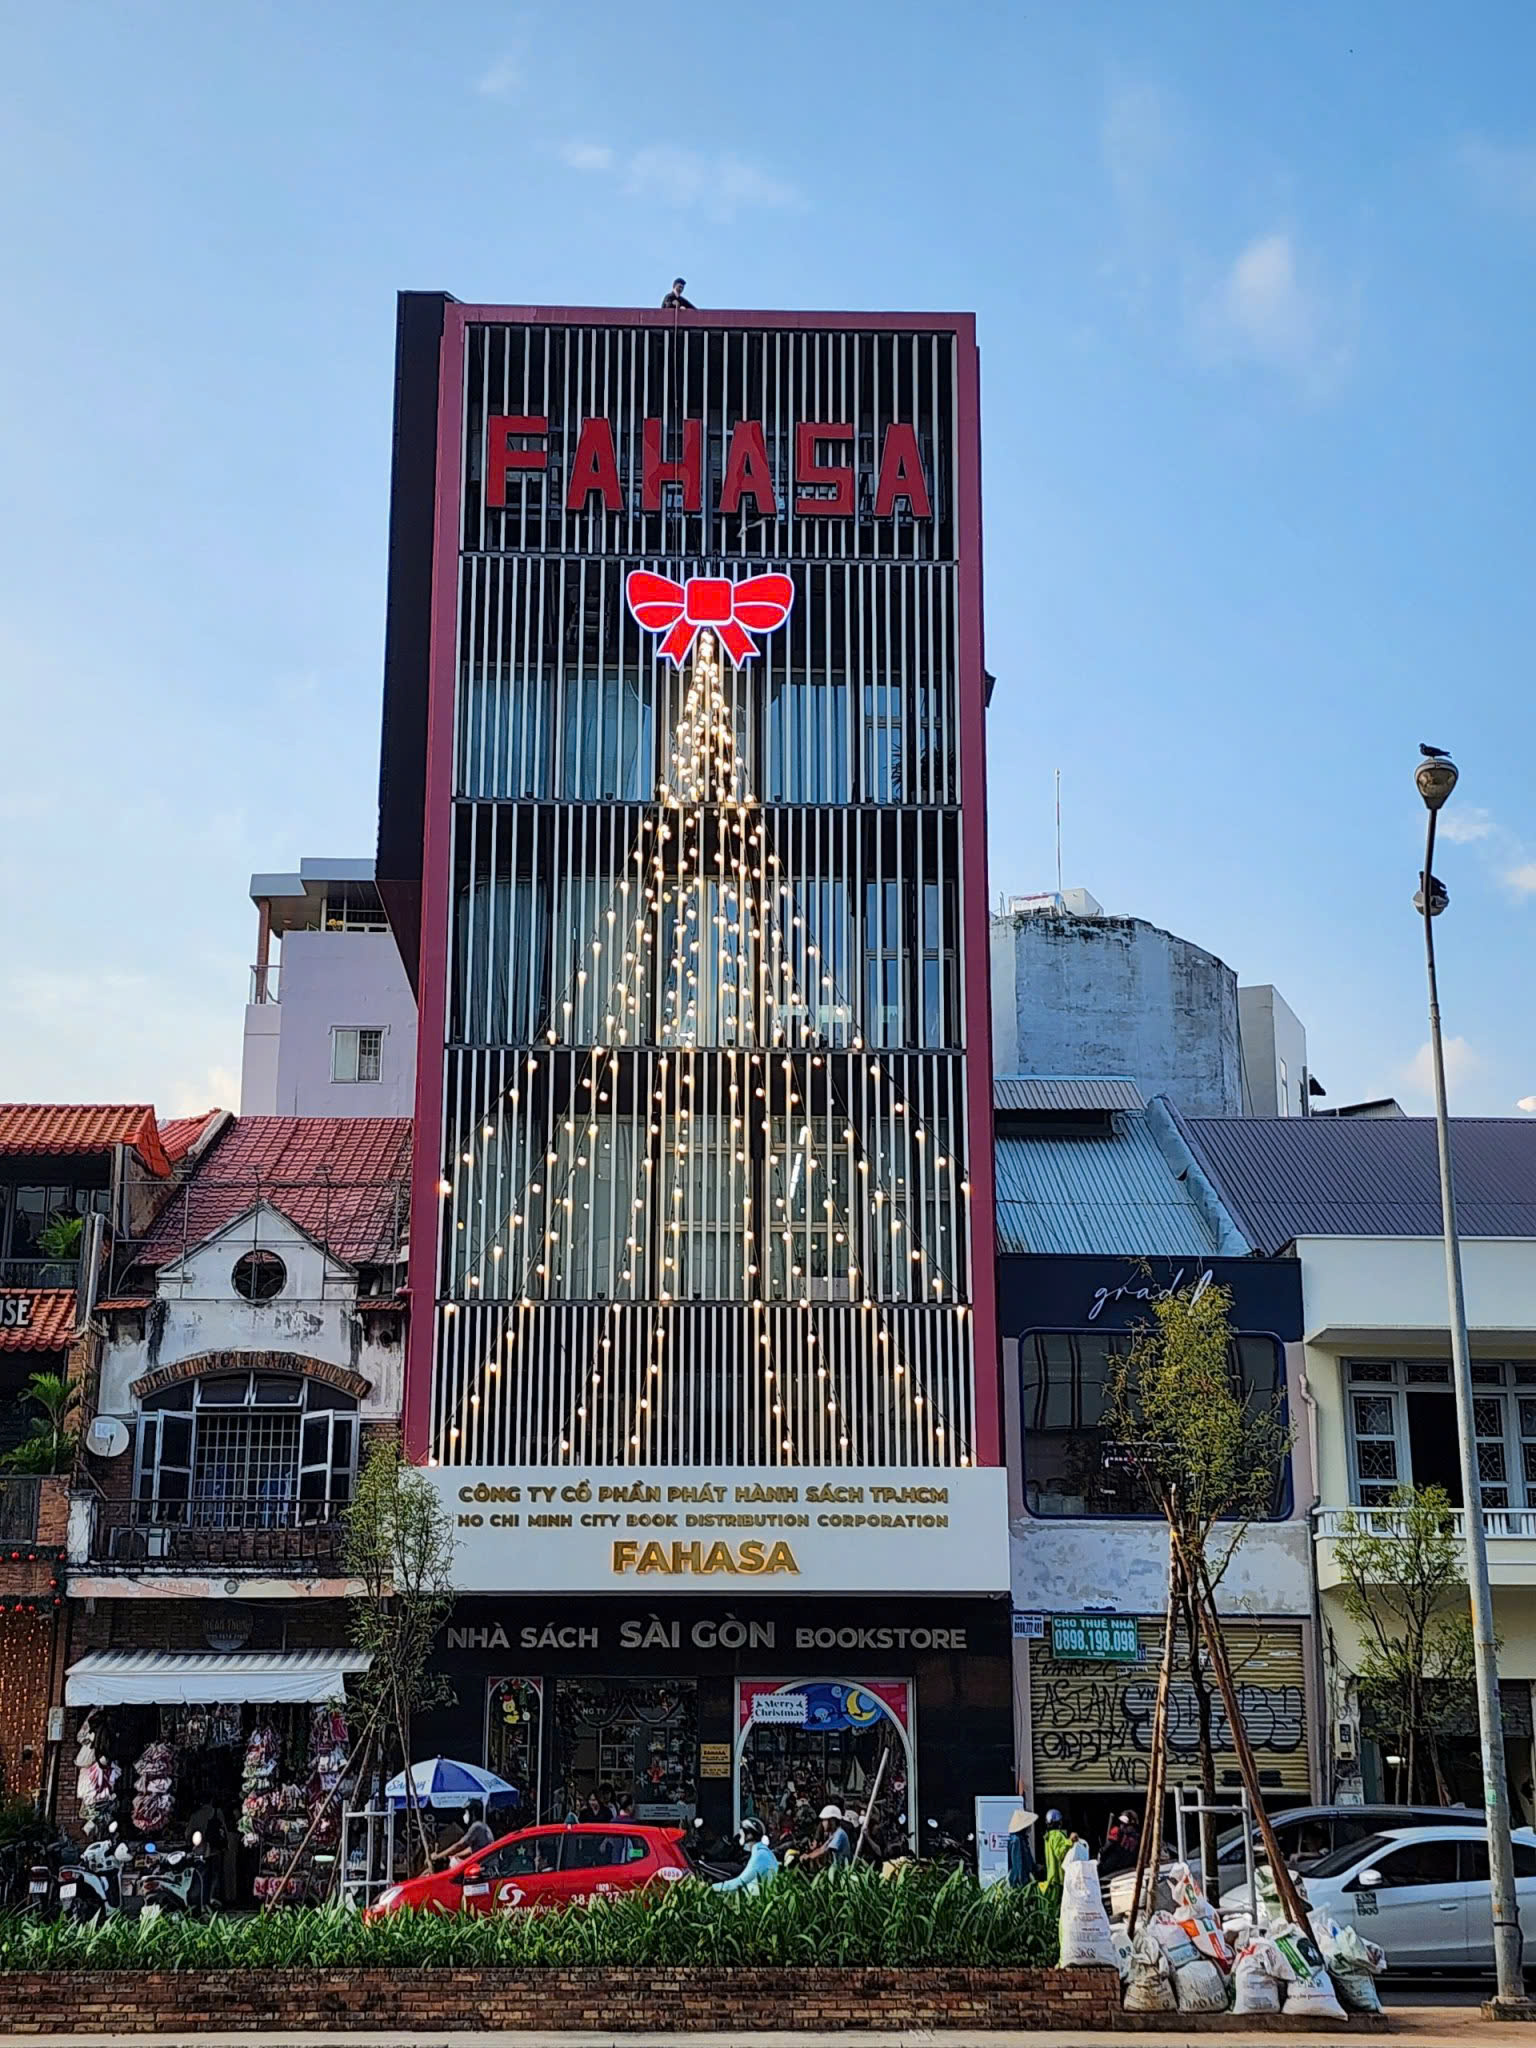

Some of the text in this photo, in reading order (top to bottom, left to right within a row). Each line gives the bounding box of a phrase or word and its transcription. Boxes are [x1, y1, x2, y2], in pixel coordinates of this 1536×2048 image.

[486, 415, 932, 518] FAHASA
[0, 1299, 30, 1325] SE
[458, 1482, 521, 1503] CÔNG
[527, 1486, 557, 1502] TY
[561, 1479, 592, 1503] CỔ
[667, 1482, 727, 1503] PHÁT
[735, 1482, 798, 1503] HÀNH
[805, 1482, 864, 1503] SÁCH
[868, 1486, 949, 1504] TP.HCM
[457, 1514, 949, 1528] HO CHI MINH CITY BOOK DISTRIBUTION CORPORATION
[611, 1540, 801, 1574] FAHASA
[446, 1613, 967, 1649] NHÀ SÁCH SÀI GÒN BOOKSTORE
[1054, 1618, 1077, 1628] CHO
[1080, 1617, 1109, 1629] THUÊ
[1111, 1618, 1134, 1629] NHÀ
[1054, 1629, 1135, 1652] 0898.198.098
[755, 1708, 804, 1717] Christmas
[764, 1700, 794, 1710] Merry
